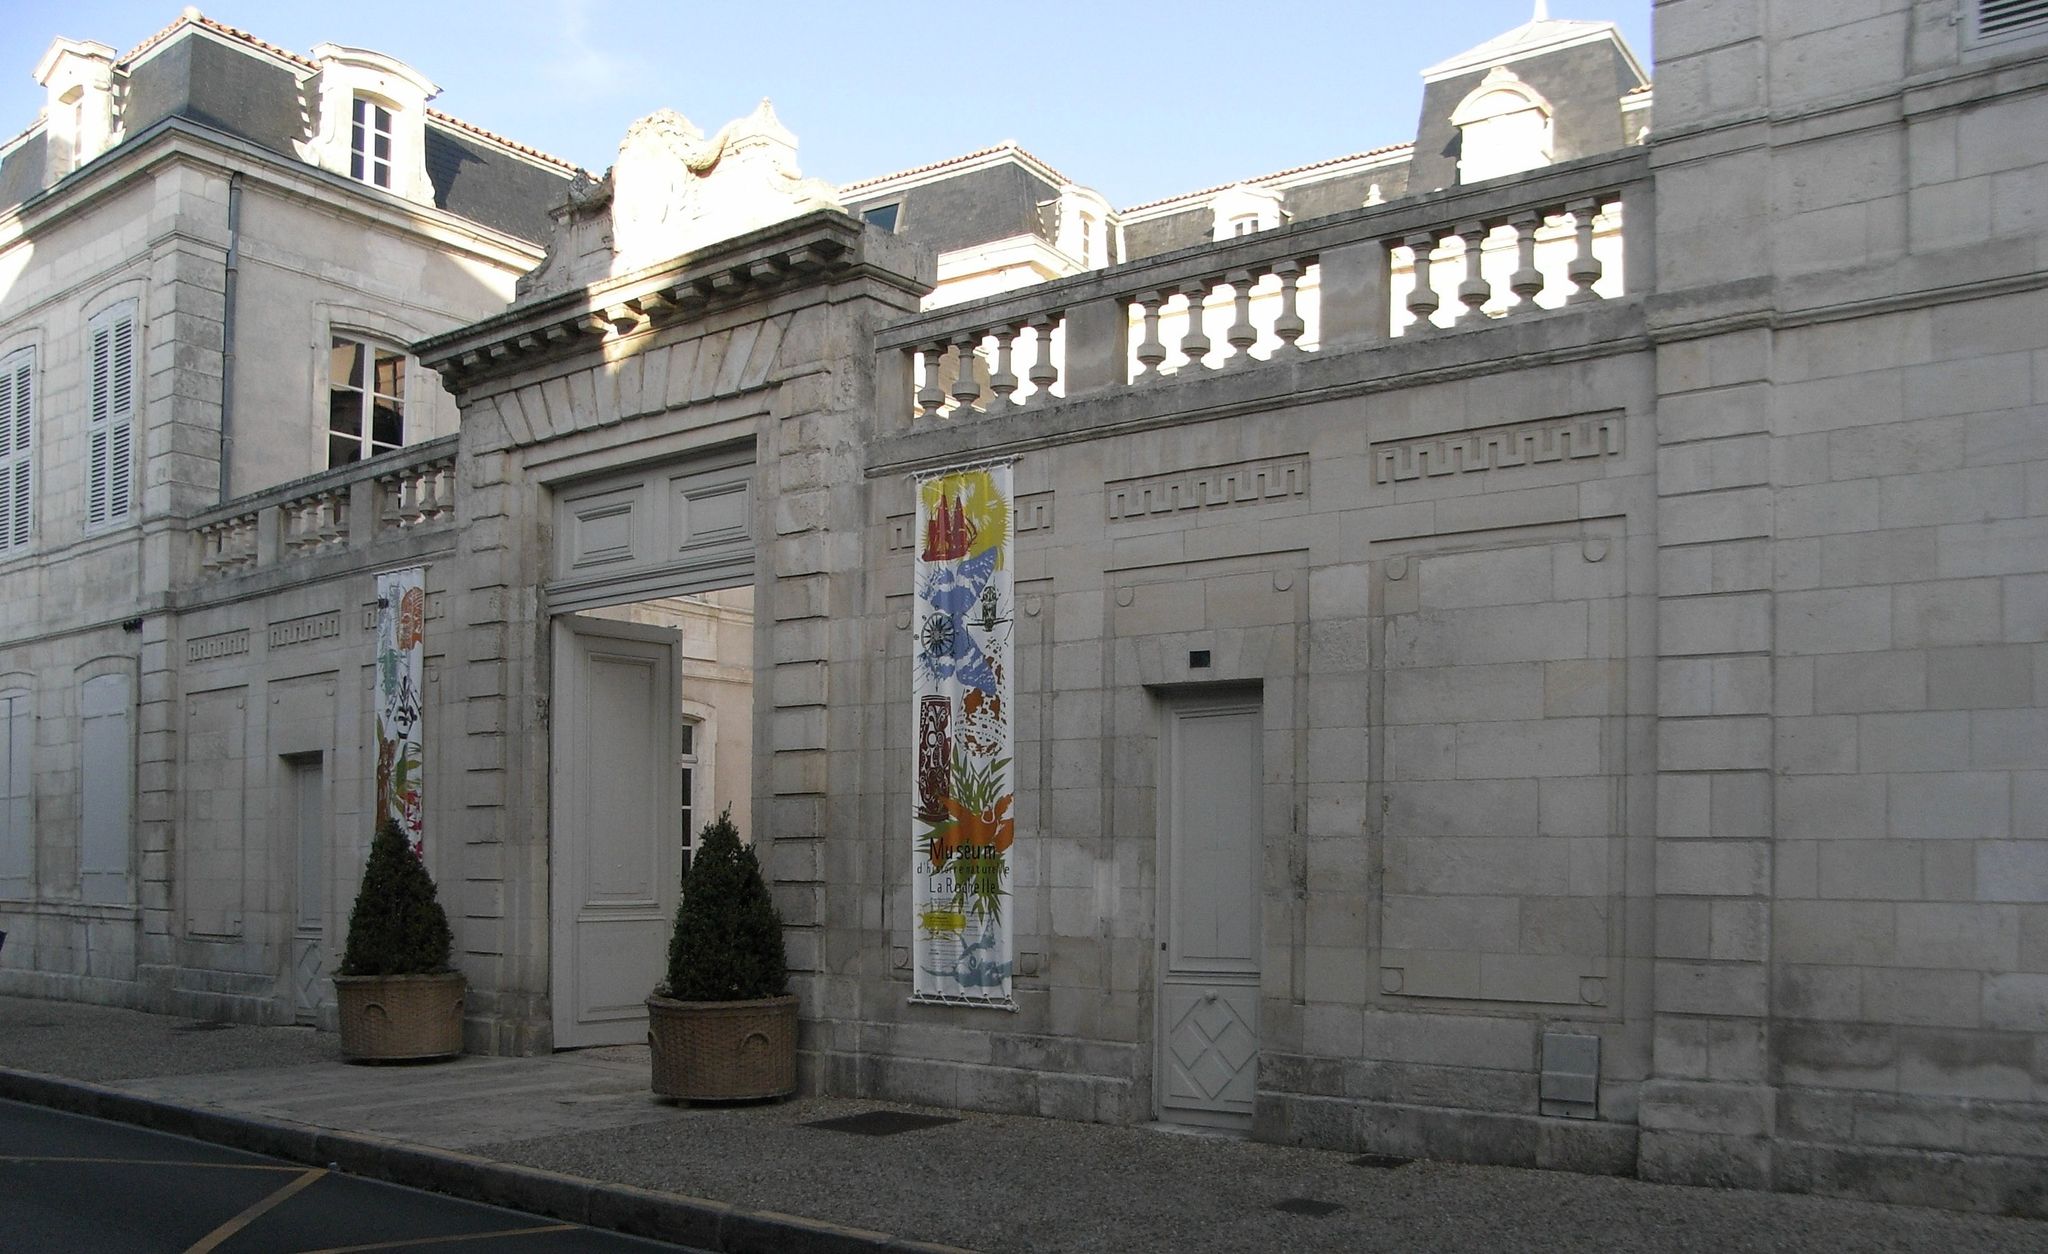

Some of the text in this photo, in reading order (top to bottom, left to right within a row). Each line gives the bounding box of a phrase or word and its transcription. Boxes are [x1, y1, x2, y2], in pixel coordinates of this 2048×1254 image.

[929, 837, 996, 860] Muséum
[929, 877, 996, 894] La Rochelle
